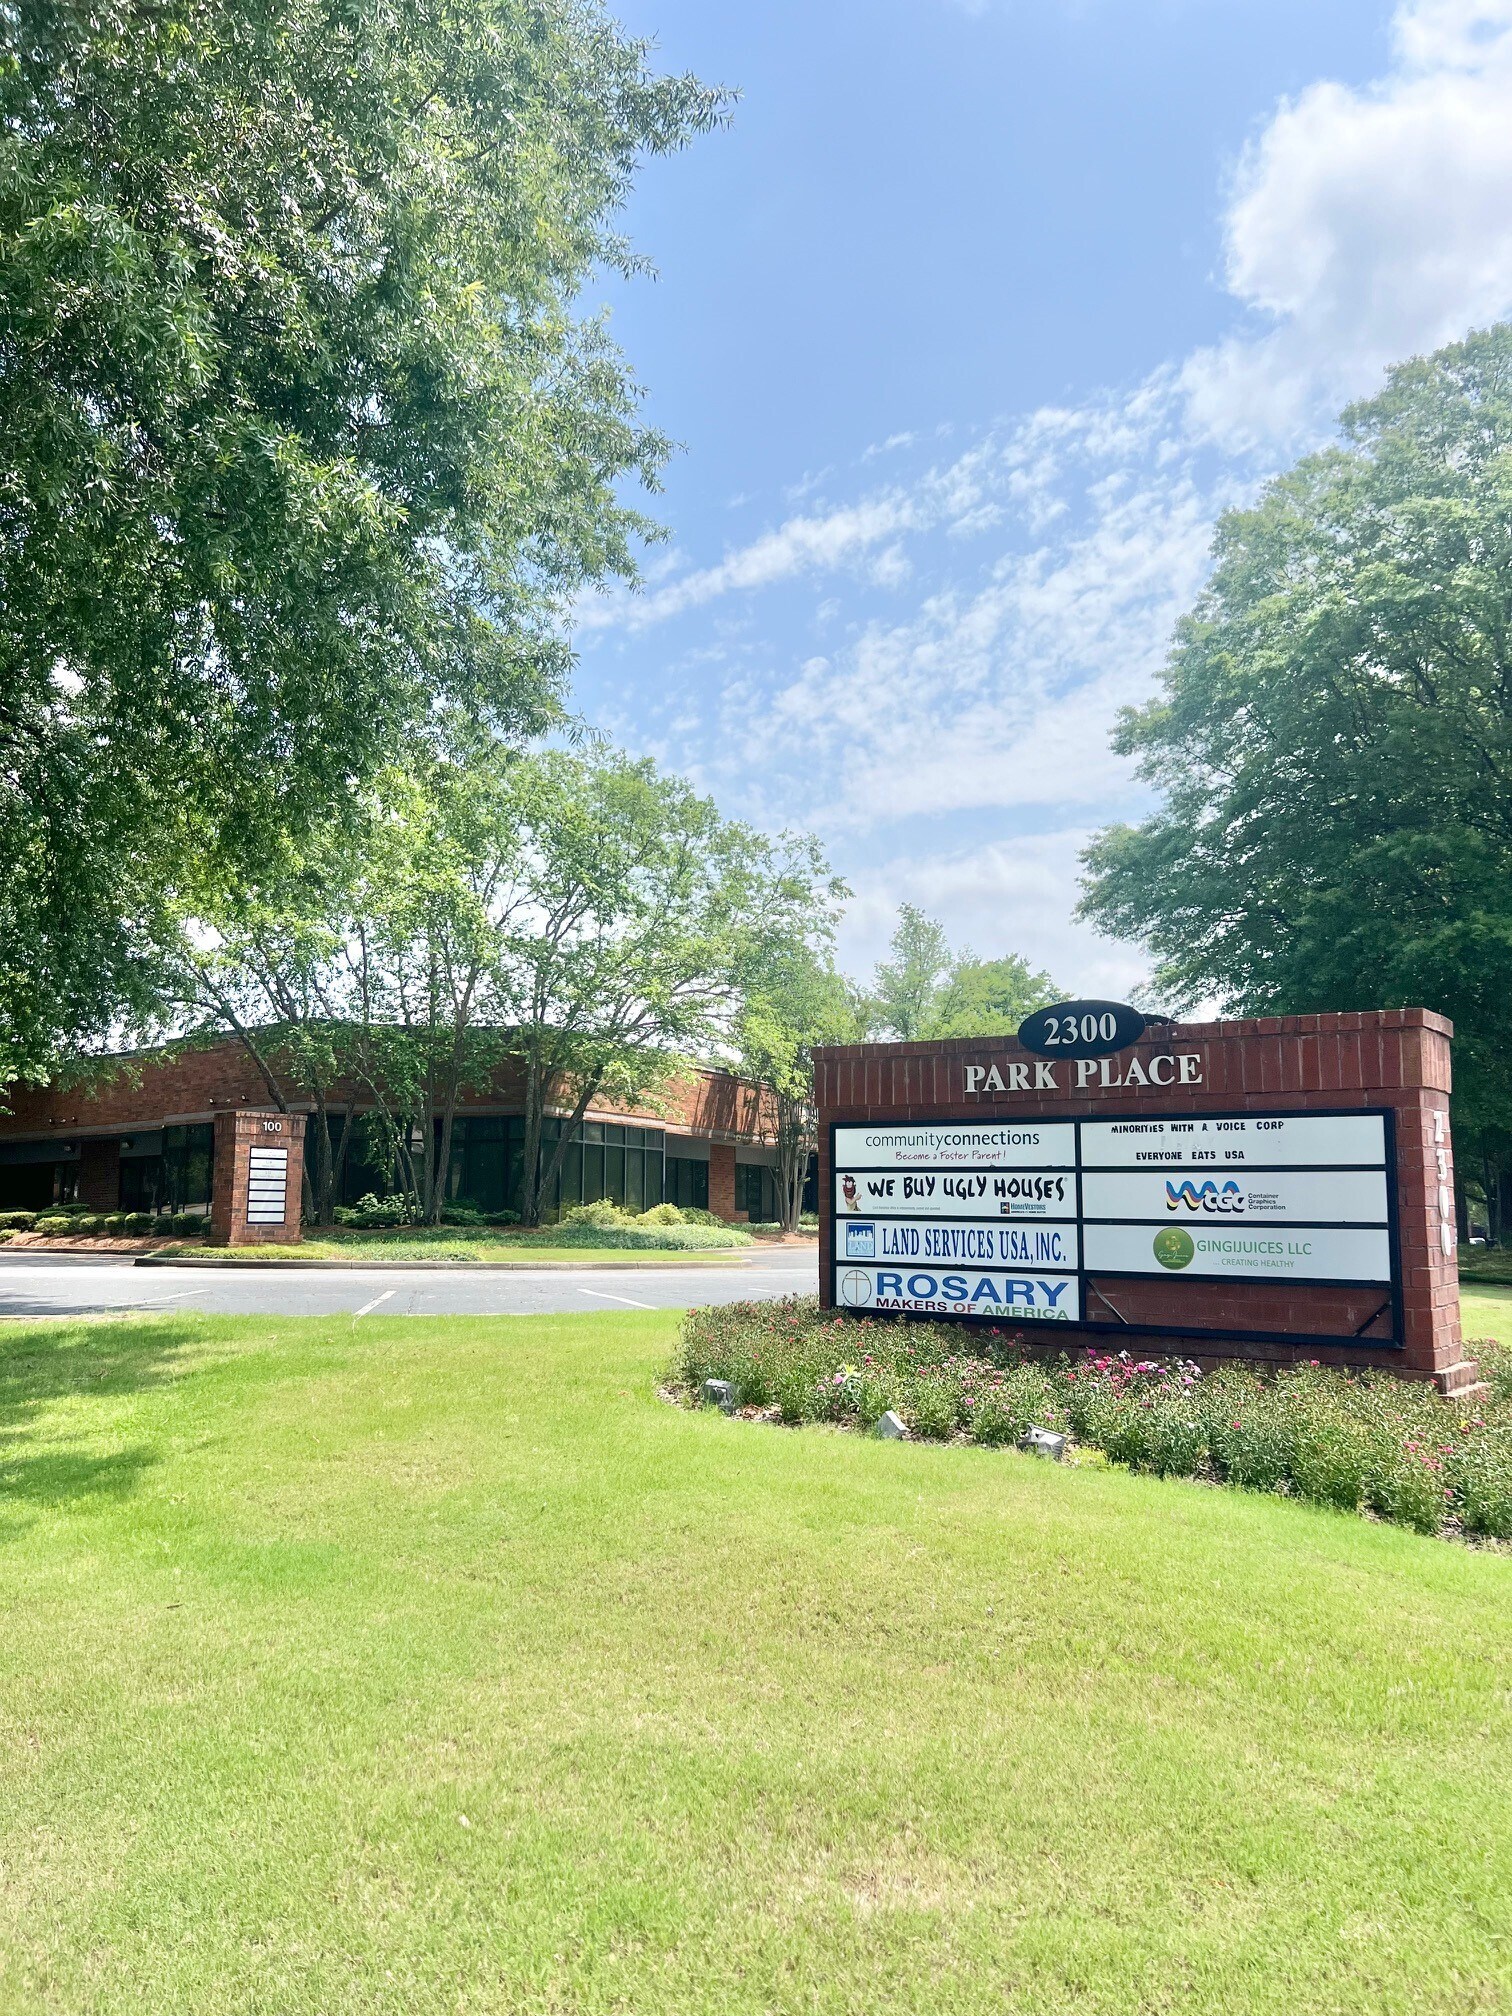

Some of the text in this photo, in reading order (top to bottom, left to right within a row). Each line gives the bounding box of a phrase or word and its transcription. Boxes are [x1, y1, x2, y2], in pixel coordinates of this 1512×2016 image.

[1043, 1012, 1118, 1046] 2300
[964, 1053, 1204, 1094] PARK PLACE
[262, 1121, 282, 1132] 100
[1111, 1121, 1285, 1134] MINORITIES WITH A VOICE CORP
[895, 1151, 931, 1161] Become
[932, 1153, 938, 1161] a
[940, 1150, 970, 1161] Foster
[1135, 1150, 1246, 1161] EVERYONE EATS USA
[867, 1175, 1066, 1202] WE BUY UGLY HOUSES
[882, 1227, 920, 1256] LAND
[924, 1228, 994, 1259] SERVICES
[1196, 1240, 1284, 1255] GINGIJUICES
[1287, 1242, 1313, 1256] LLC
[1221, 1258, 1259, 1267] CREATING
[1260, 1259, 1295, 1268] HEALTHY
[876, 1272, 1070, 1307] ROSARY
[876, 1297, 1070, 1321] MAKERS OF AMERICA
